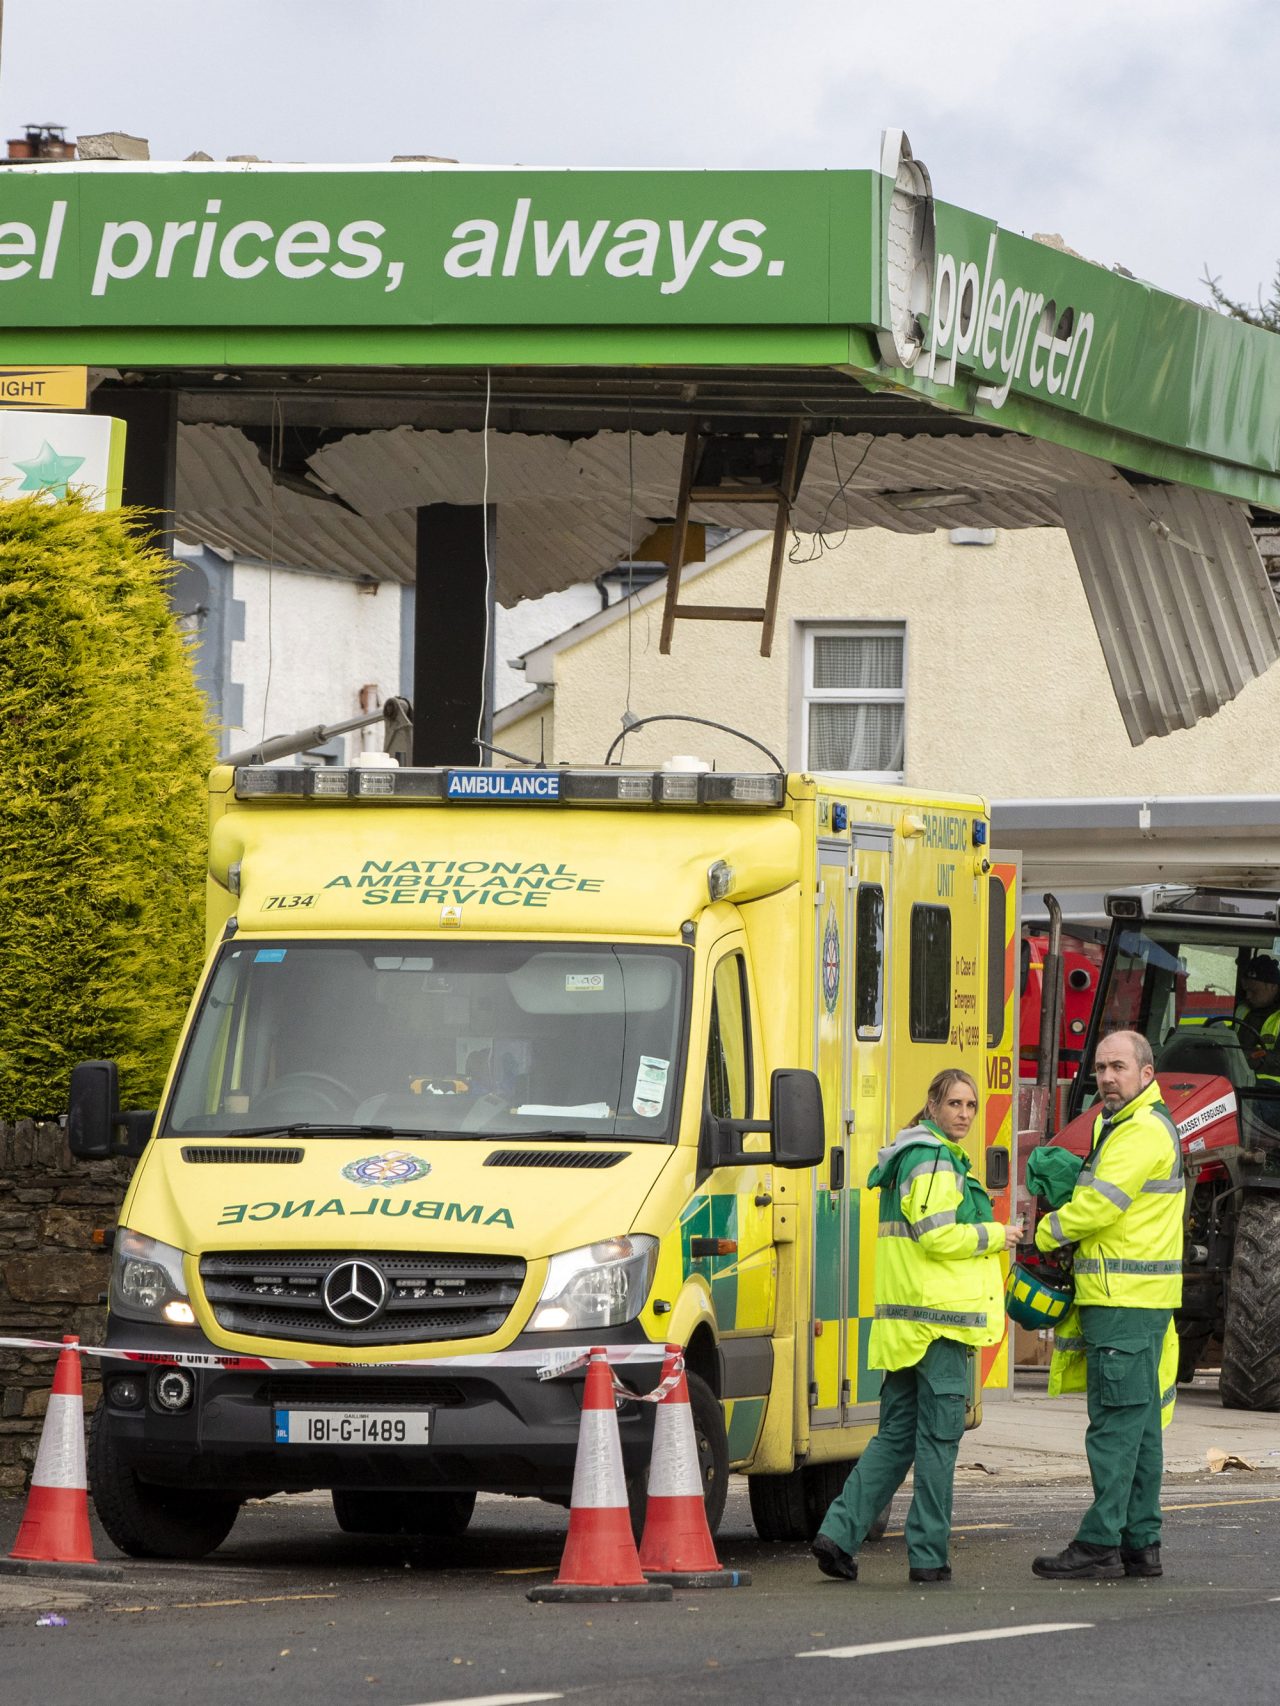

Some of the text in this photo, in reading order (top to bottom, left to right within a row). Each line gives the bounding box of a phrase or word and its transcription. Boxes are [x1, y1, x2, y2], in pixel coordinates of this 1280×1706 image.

[91, 198, 407, 296] prices,
[443, 197, 784, 295] always.
[449, 776, 559, 795] AMBULANCE
[922, 814, 968, 852] PARAMEDIC
[360, 860, 578, 876] NATIONAL
[323, 875, 605, 893] AMBULANCE
[937, 863, 955, 897] UNIT
[265, 895, 314, 910] 7L34
[362, 889, 552, 907] SERVICE
[954, 989, 977, 1015] Emergency
[1180, 1103, 1227, 1134] MASSEY FERGUSON
[912, 1310, 967, 1323] AMBULANCE
[277, 1419, 406, 1442] IRL 181-G-1489
